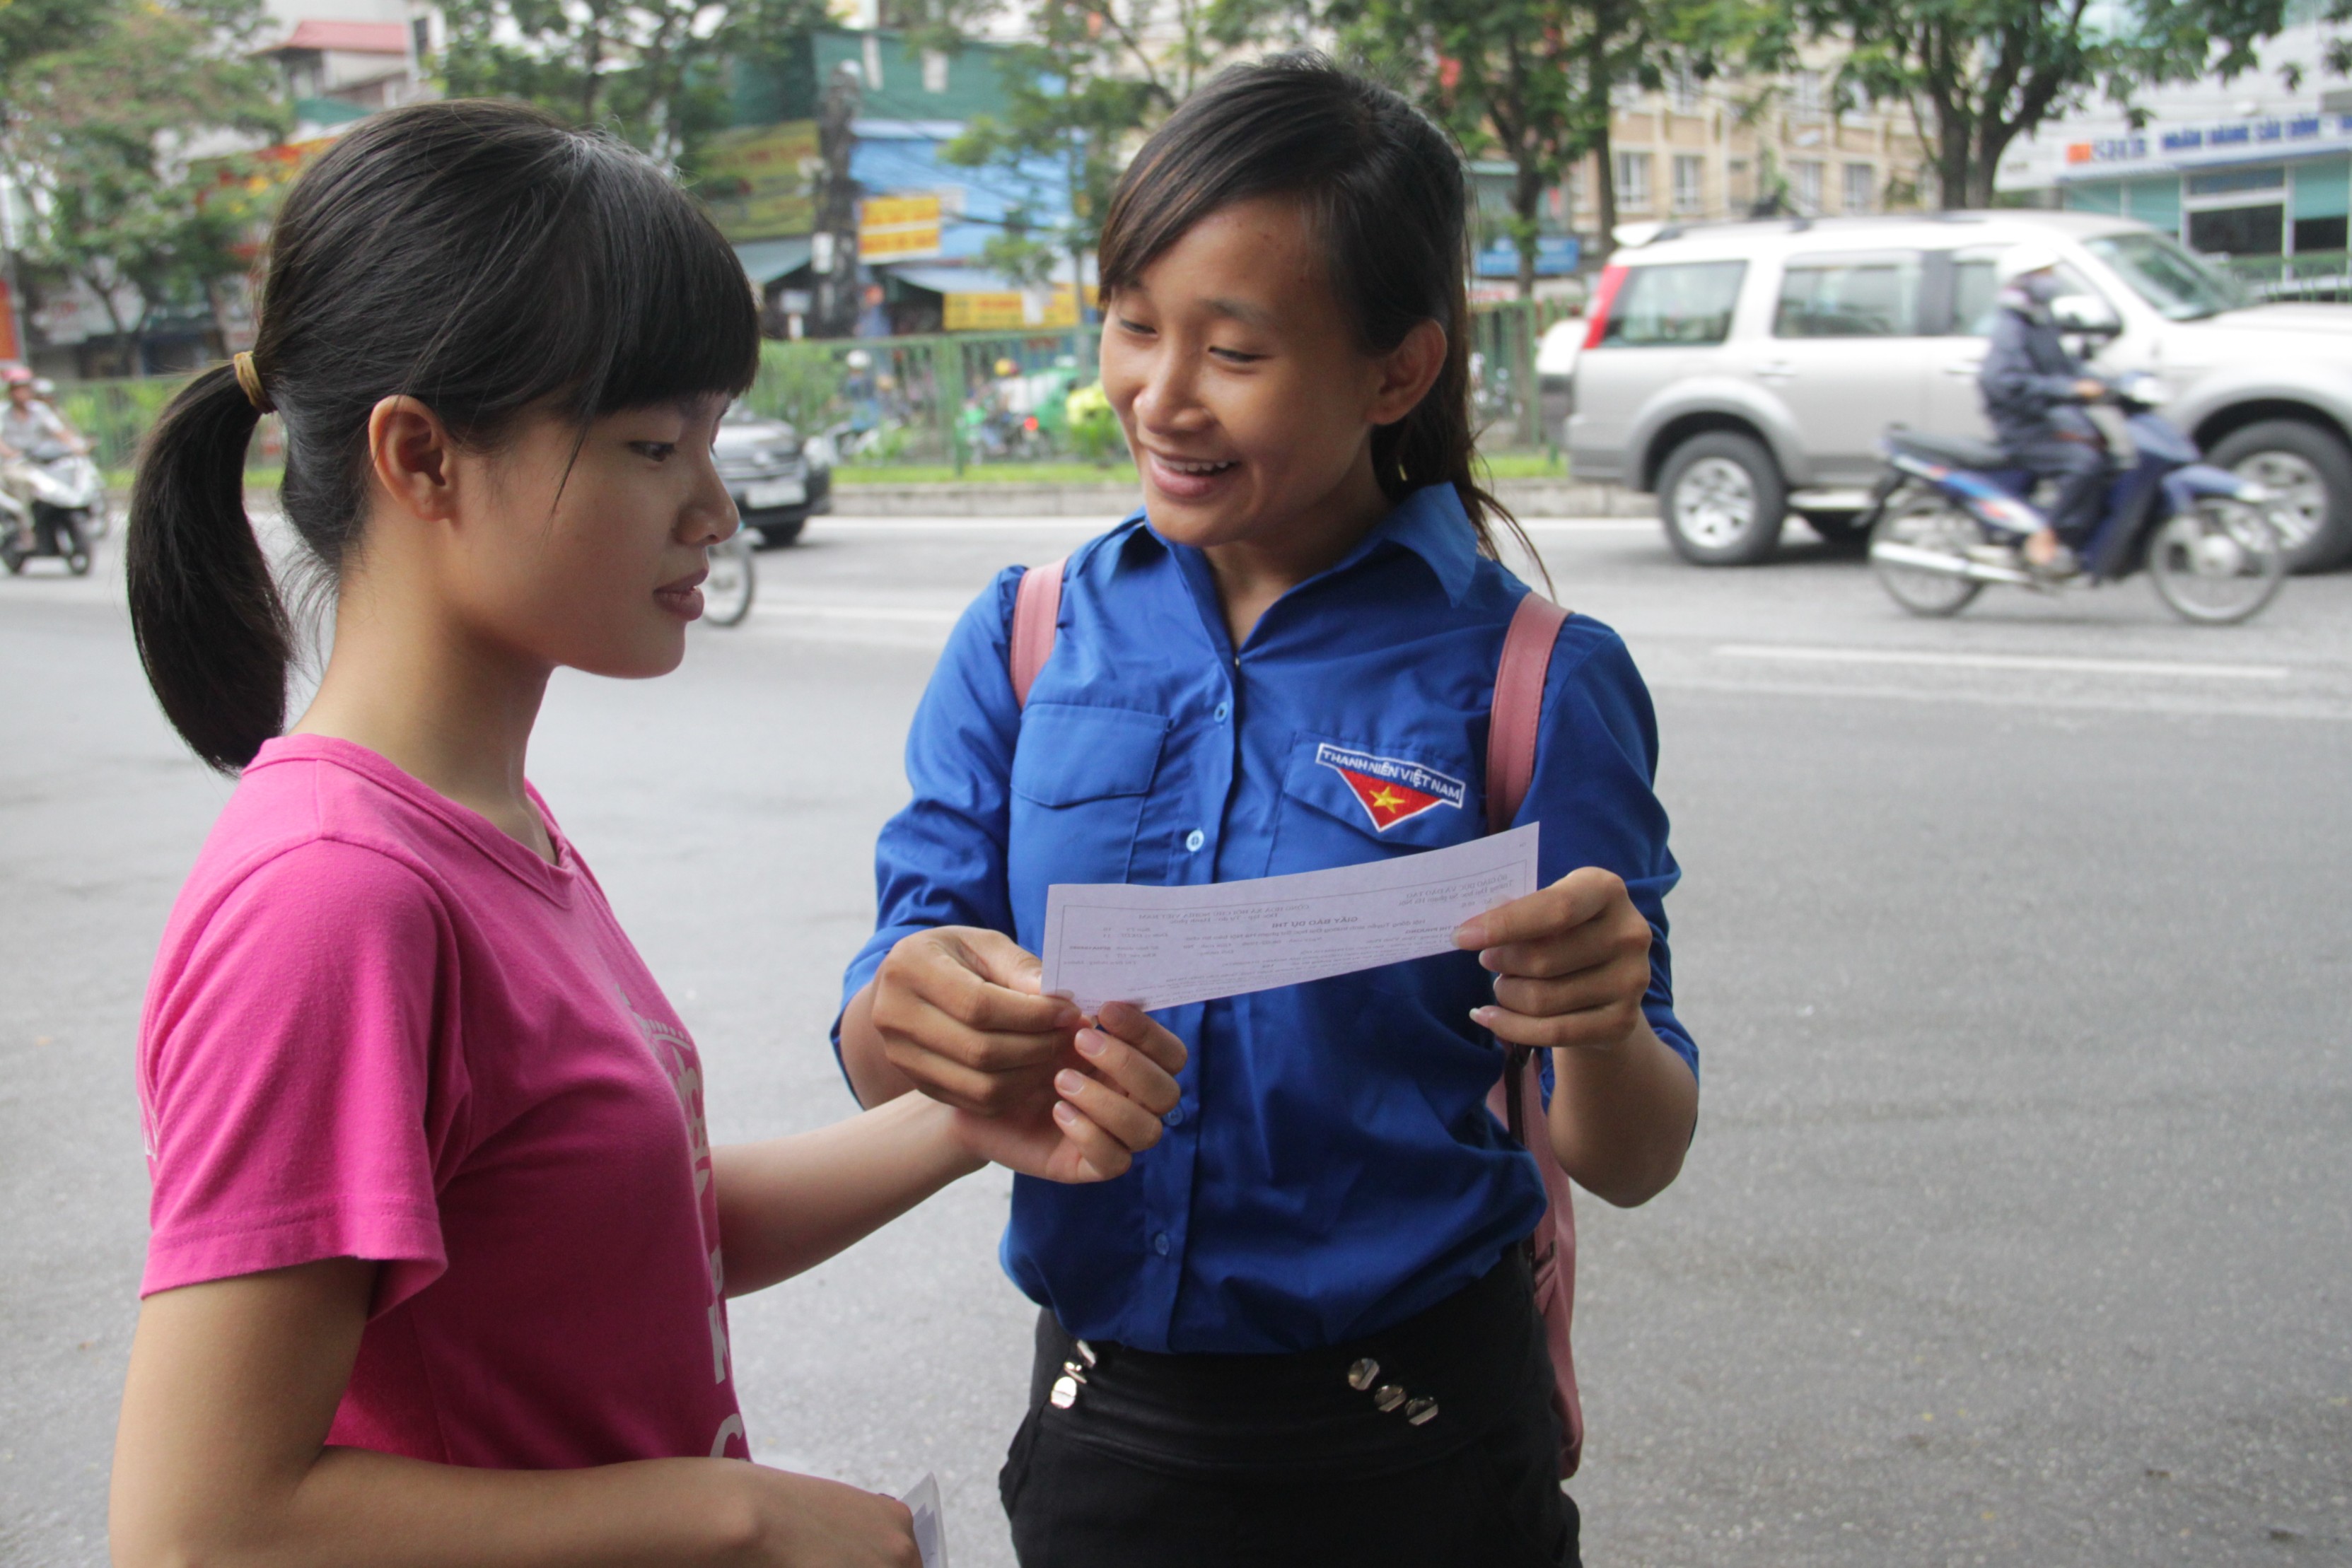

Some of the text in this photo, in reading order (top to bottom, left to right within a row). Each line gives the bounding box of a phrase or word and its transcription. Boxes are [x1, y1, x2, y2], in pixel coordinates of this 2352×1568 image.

[1322, 749, 1461, 800] THANH NIÊN VIỆT NAM
